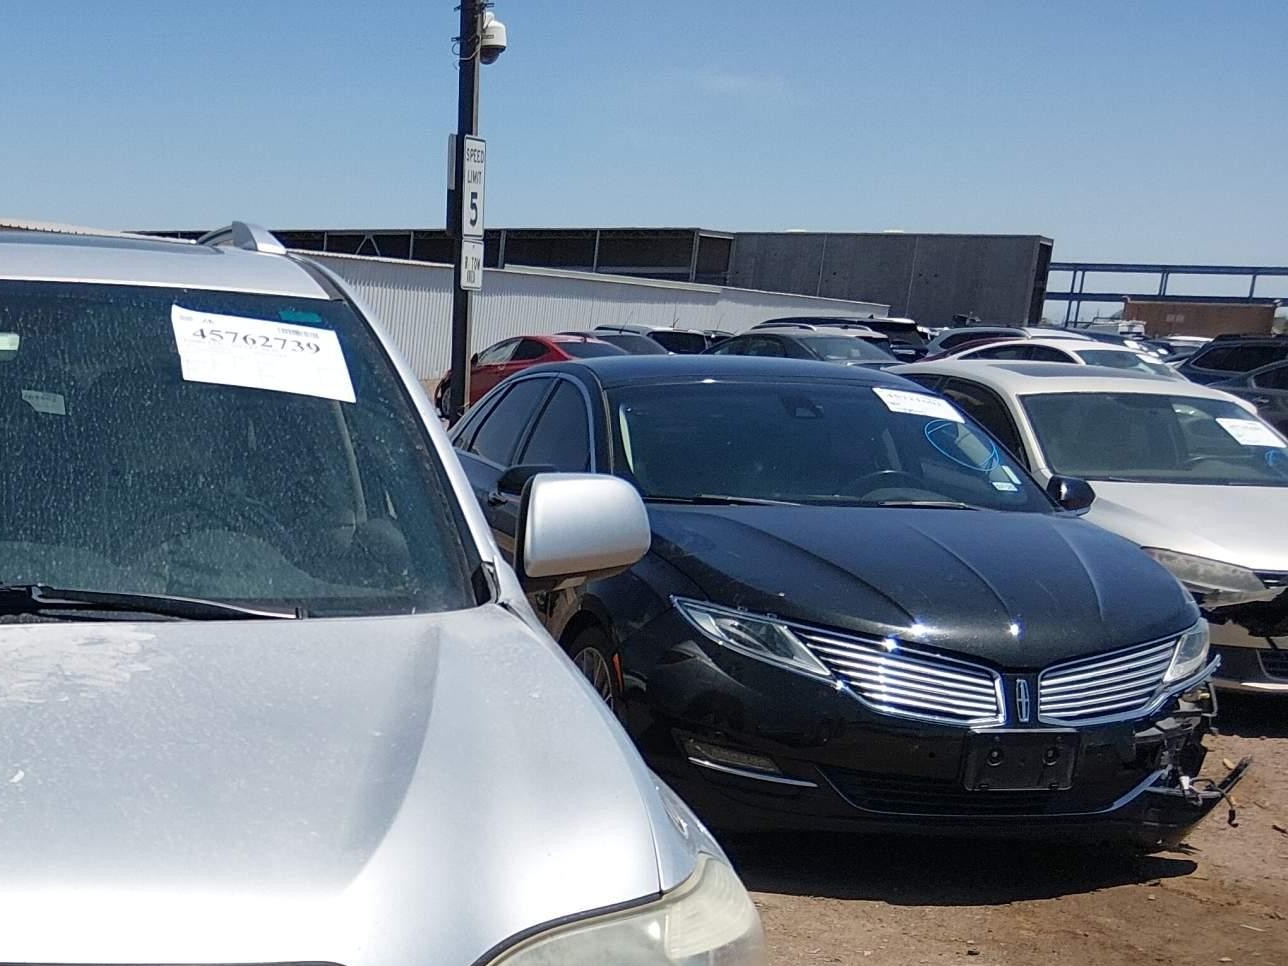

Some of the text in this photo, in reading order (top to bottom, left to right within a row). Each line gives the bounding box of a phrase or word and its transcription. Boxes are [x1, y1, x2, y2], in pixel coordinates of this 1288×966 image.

[466, 148, 484, 163] SPEED
[467, 169, 482, 184] LIMIT
[469, 191, 478, 226] 5
[193, 327, 321, 354] 45762739
